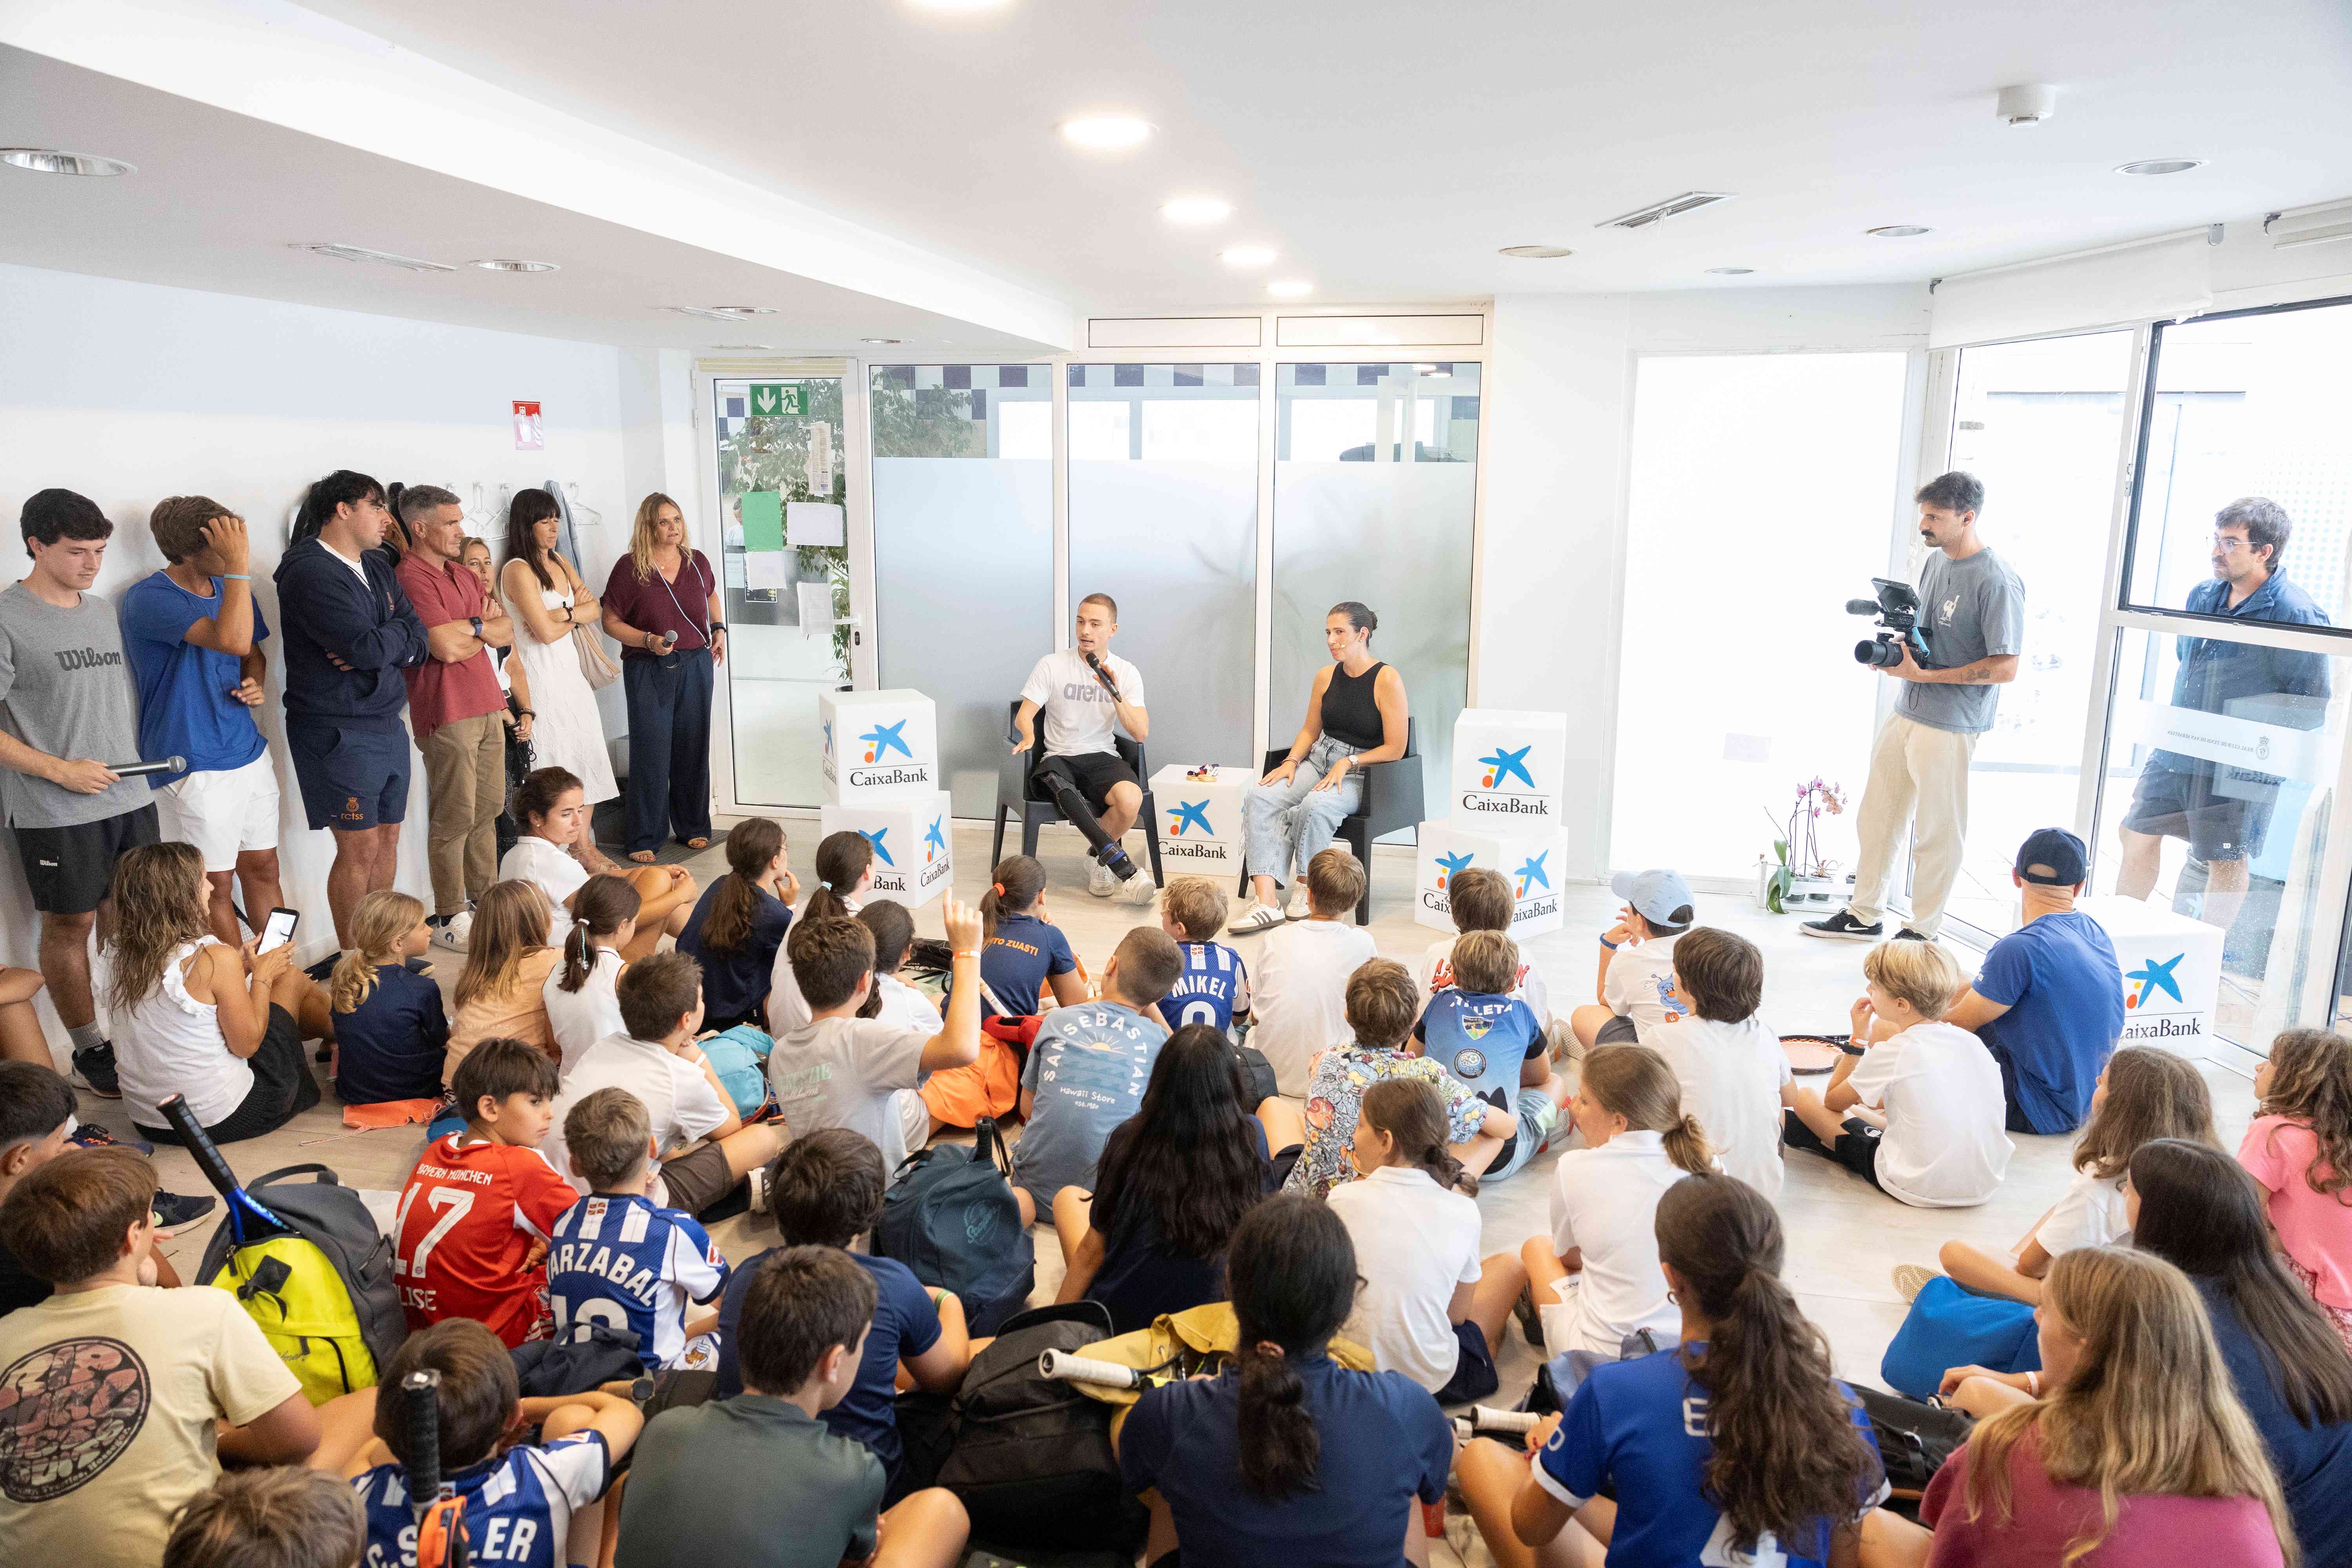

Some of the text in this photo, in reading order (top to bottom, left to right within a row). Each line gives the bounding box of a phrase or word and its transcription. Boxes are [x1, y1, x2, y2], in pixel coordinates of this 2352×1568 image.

[54, 647, 122, 671] Wilson
[850, 768, 928, 786] CaixaBank
[1463, 795, 1548, 815] CaixaBank
[341, 812, 364, 820] rctss
[1158, 841, 1227, 859] CaixaBank
[921, 857, 950, 887] CaixaBank
[873, 875, 906, 891] Bank
[1424, 893, 1451, 914] Caix
[1512, 898, 1558, 923] aixaBank
[1006, 940, 1039, 956] ZUASTI
[1172, 975, 1227, 1000] MIKEL
[2120, 1018, 2201, 1039] aixaBank
[1044, 1039, 1067, 1082] SAN
[1063, 1012, 1147, 1096] SEBASTIAN
[1091, 1091, 1116, 1104] Store
[416, 1163, 448, 1180] BAYERN
[392, 1182, 475, 1278] 17
[546, 1242, 662, 1307] ARZABAL
